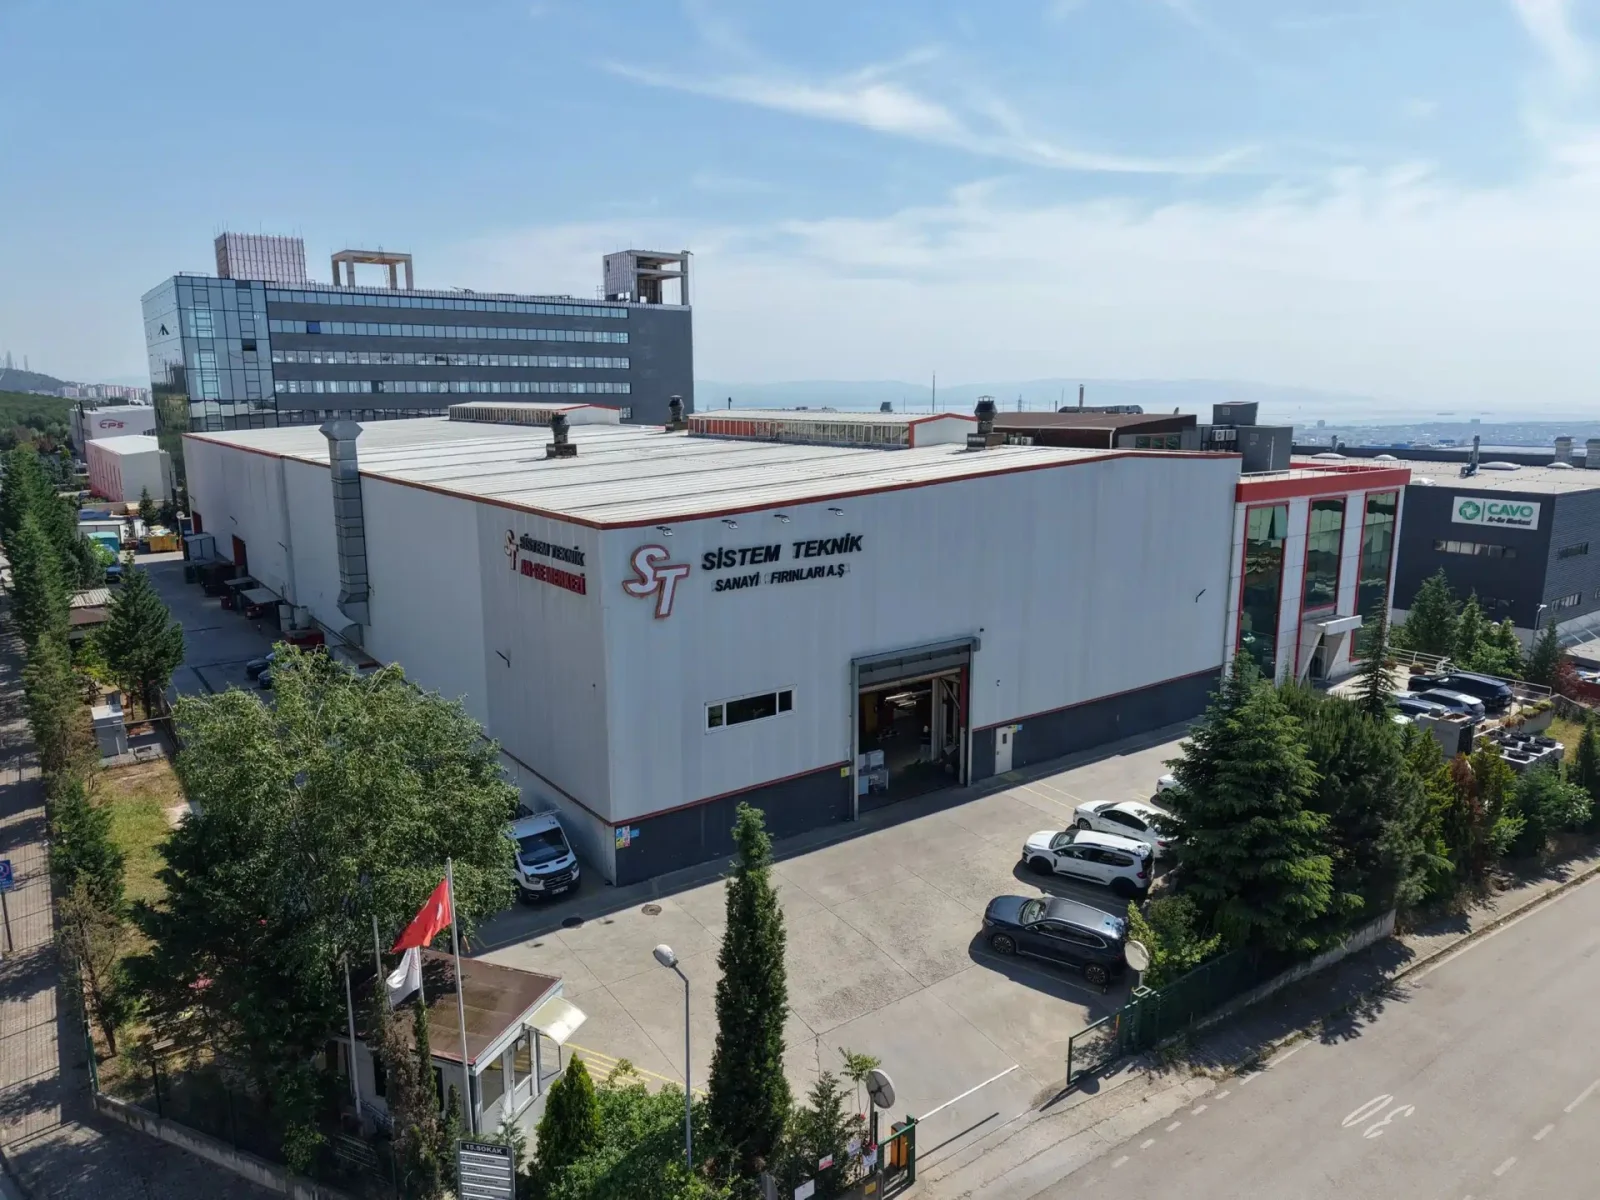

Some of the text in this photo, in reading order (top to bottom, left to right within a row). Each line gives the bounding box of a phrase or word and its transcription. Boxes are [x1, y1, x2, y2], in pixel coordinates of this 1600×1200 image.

[100, 421, 124, 429] CPS
[1487, 503, 1534, 518] CAVO
[520, 533, 586, 567] SİSTEM TEKNİK
[702, 533, 863, 571] SİSTEM TEKNİK
[622, 544, 690, 619] ST
[714, 572, 760, 592] SANAYİ
[770, 566, 825, 585] FIRINLARI
